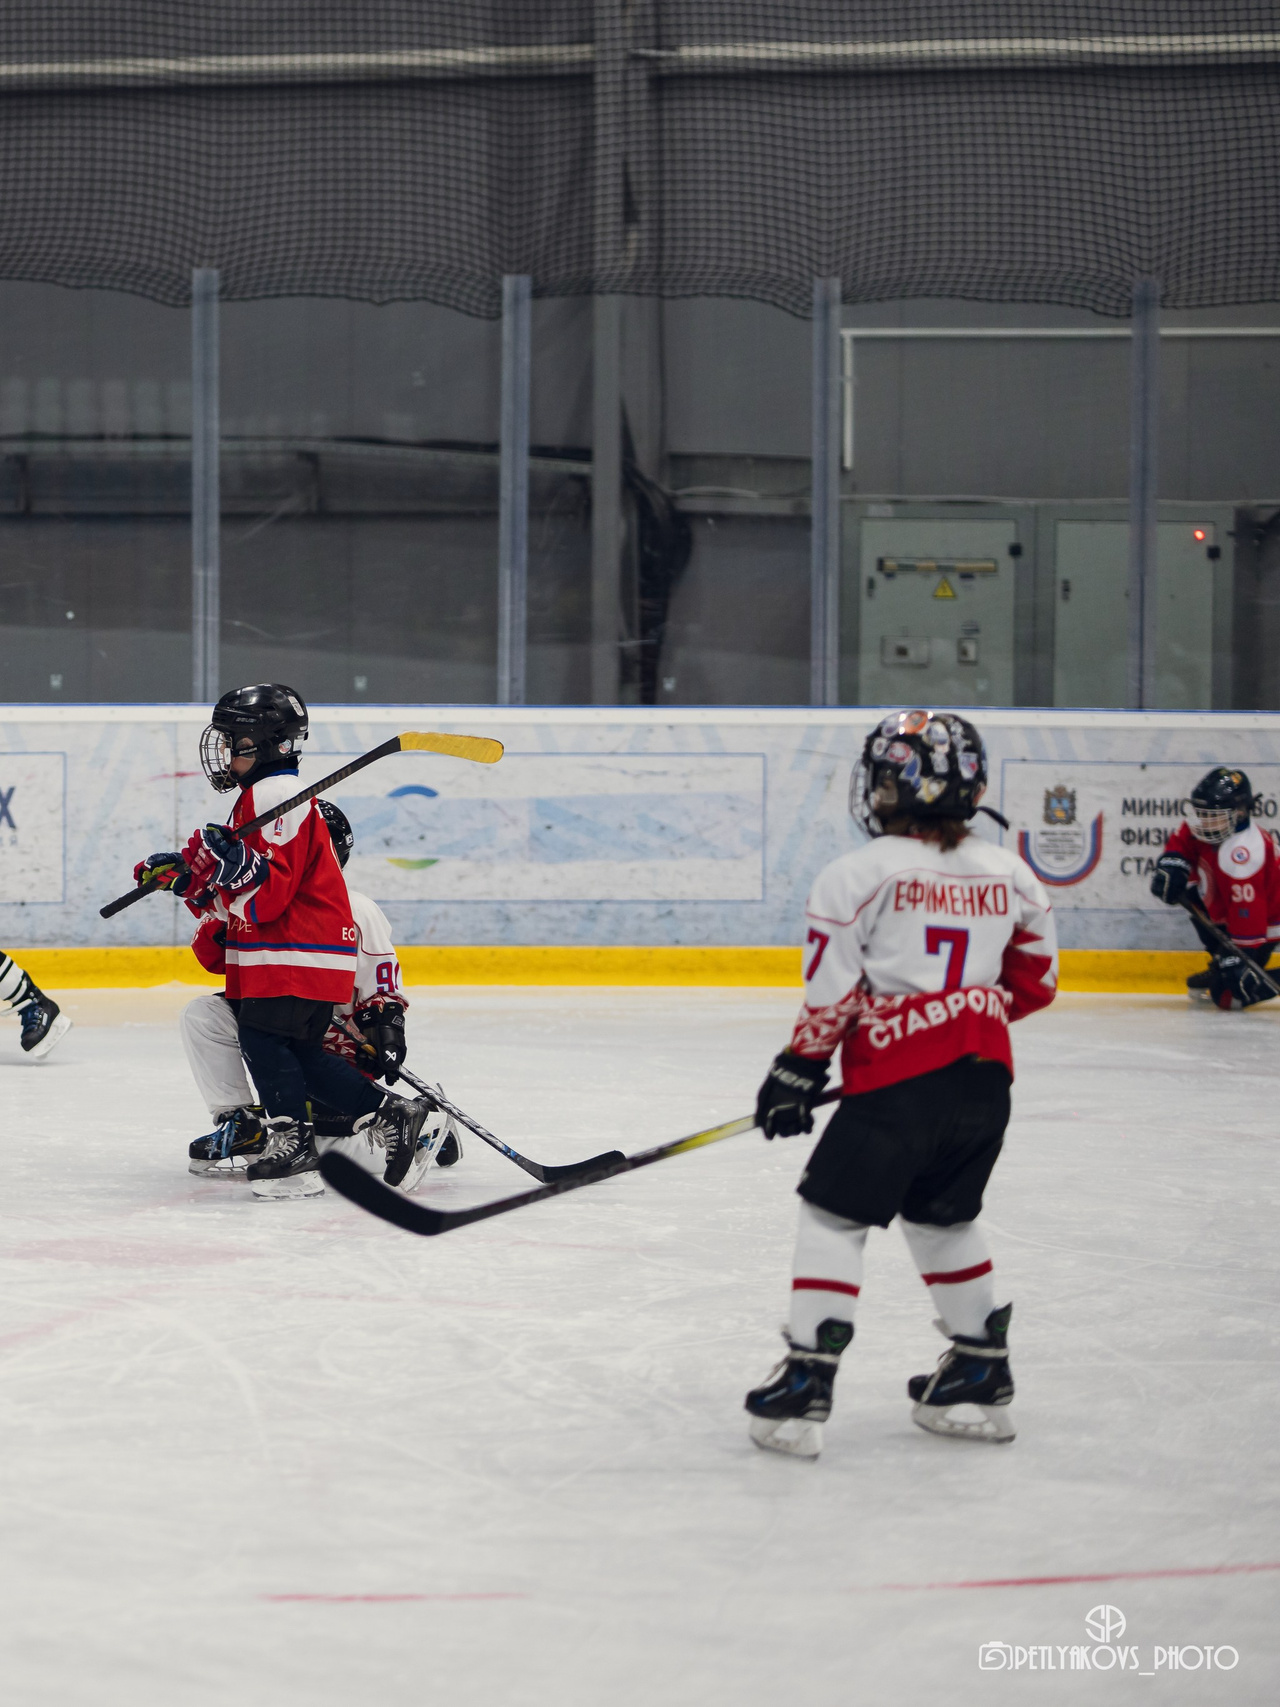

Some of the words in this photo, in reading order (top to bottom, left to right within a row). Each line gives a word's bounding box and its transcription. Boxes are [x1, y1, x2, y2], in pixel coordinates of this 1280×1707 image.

[1231, 883, 1256, 903] 30
[805, 926, 830, 983] 7
[924, 924, 970, 990] 7
[868, 986, 1013, 1049] СТАВРОП
